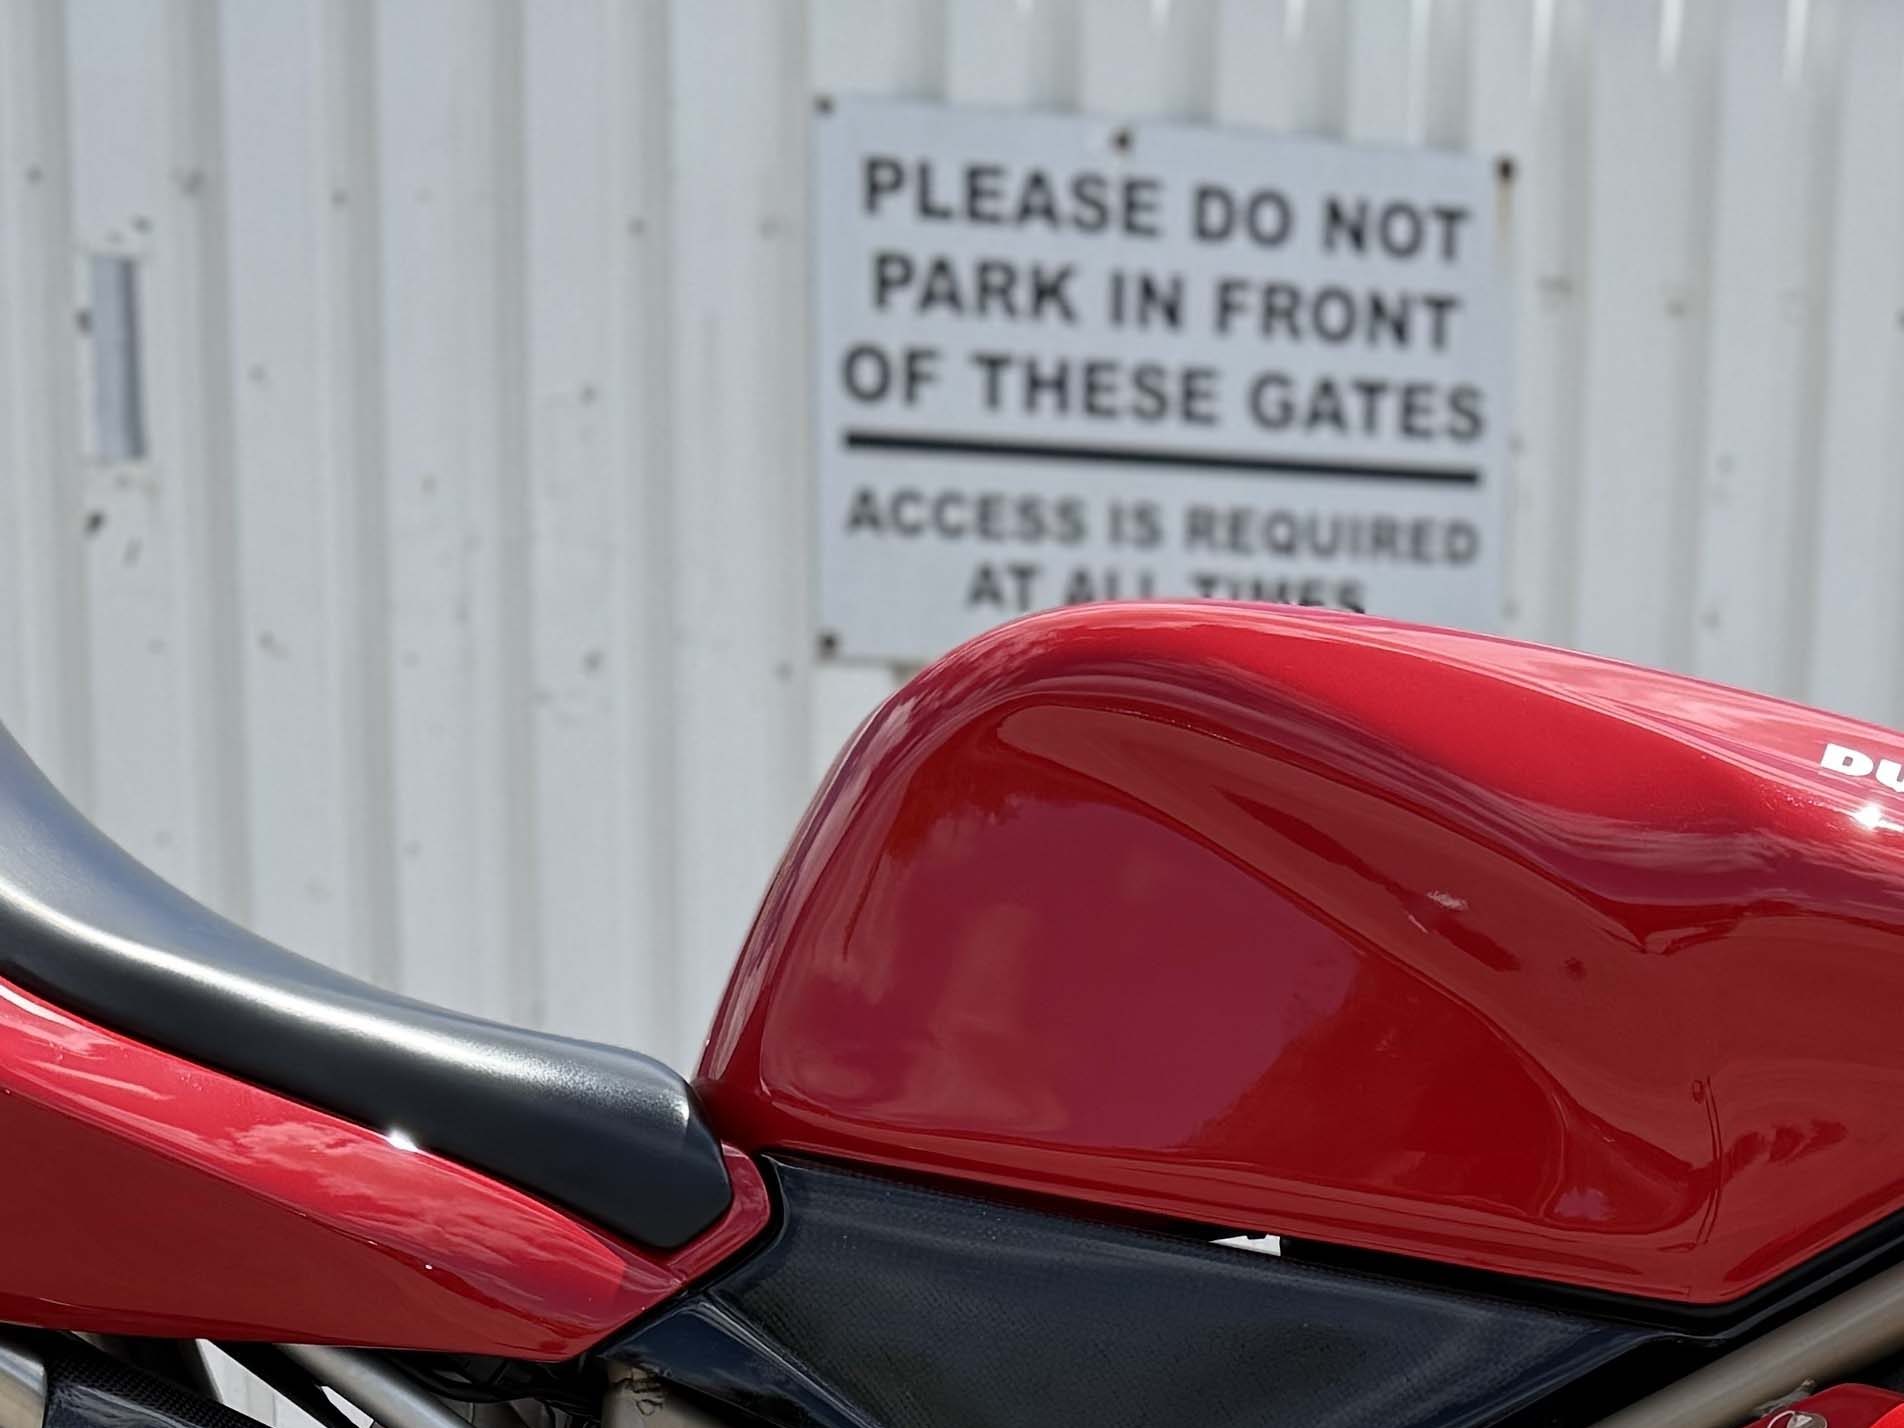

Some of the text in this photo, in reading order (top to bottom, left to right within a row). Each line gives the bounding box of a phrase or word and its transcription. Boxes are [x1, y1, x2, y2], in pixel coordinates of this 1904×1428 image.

[862, 155, 1469, 264] PLEASE DO NOT
[872, 251, 1460, 350] PARK IN FRONT
[841, 344, 1485, 443] OF THESE GATES
[846, 486, 1479, 566] ACCESS IS REQUIRED
[965, 562, 1041, 612] AT
